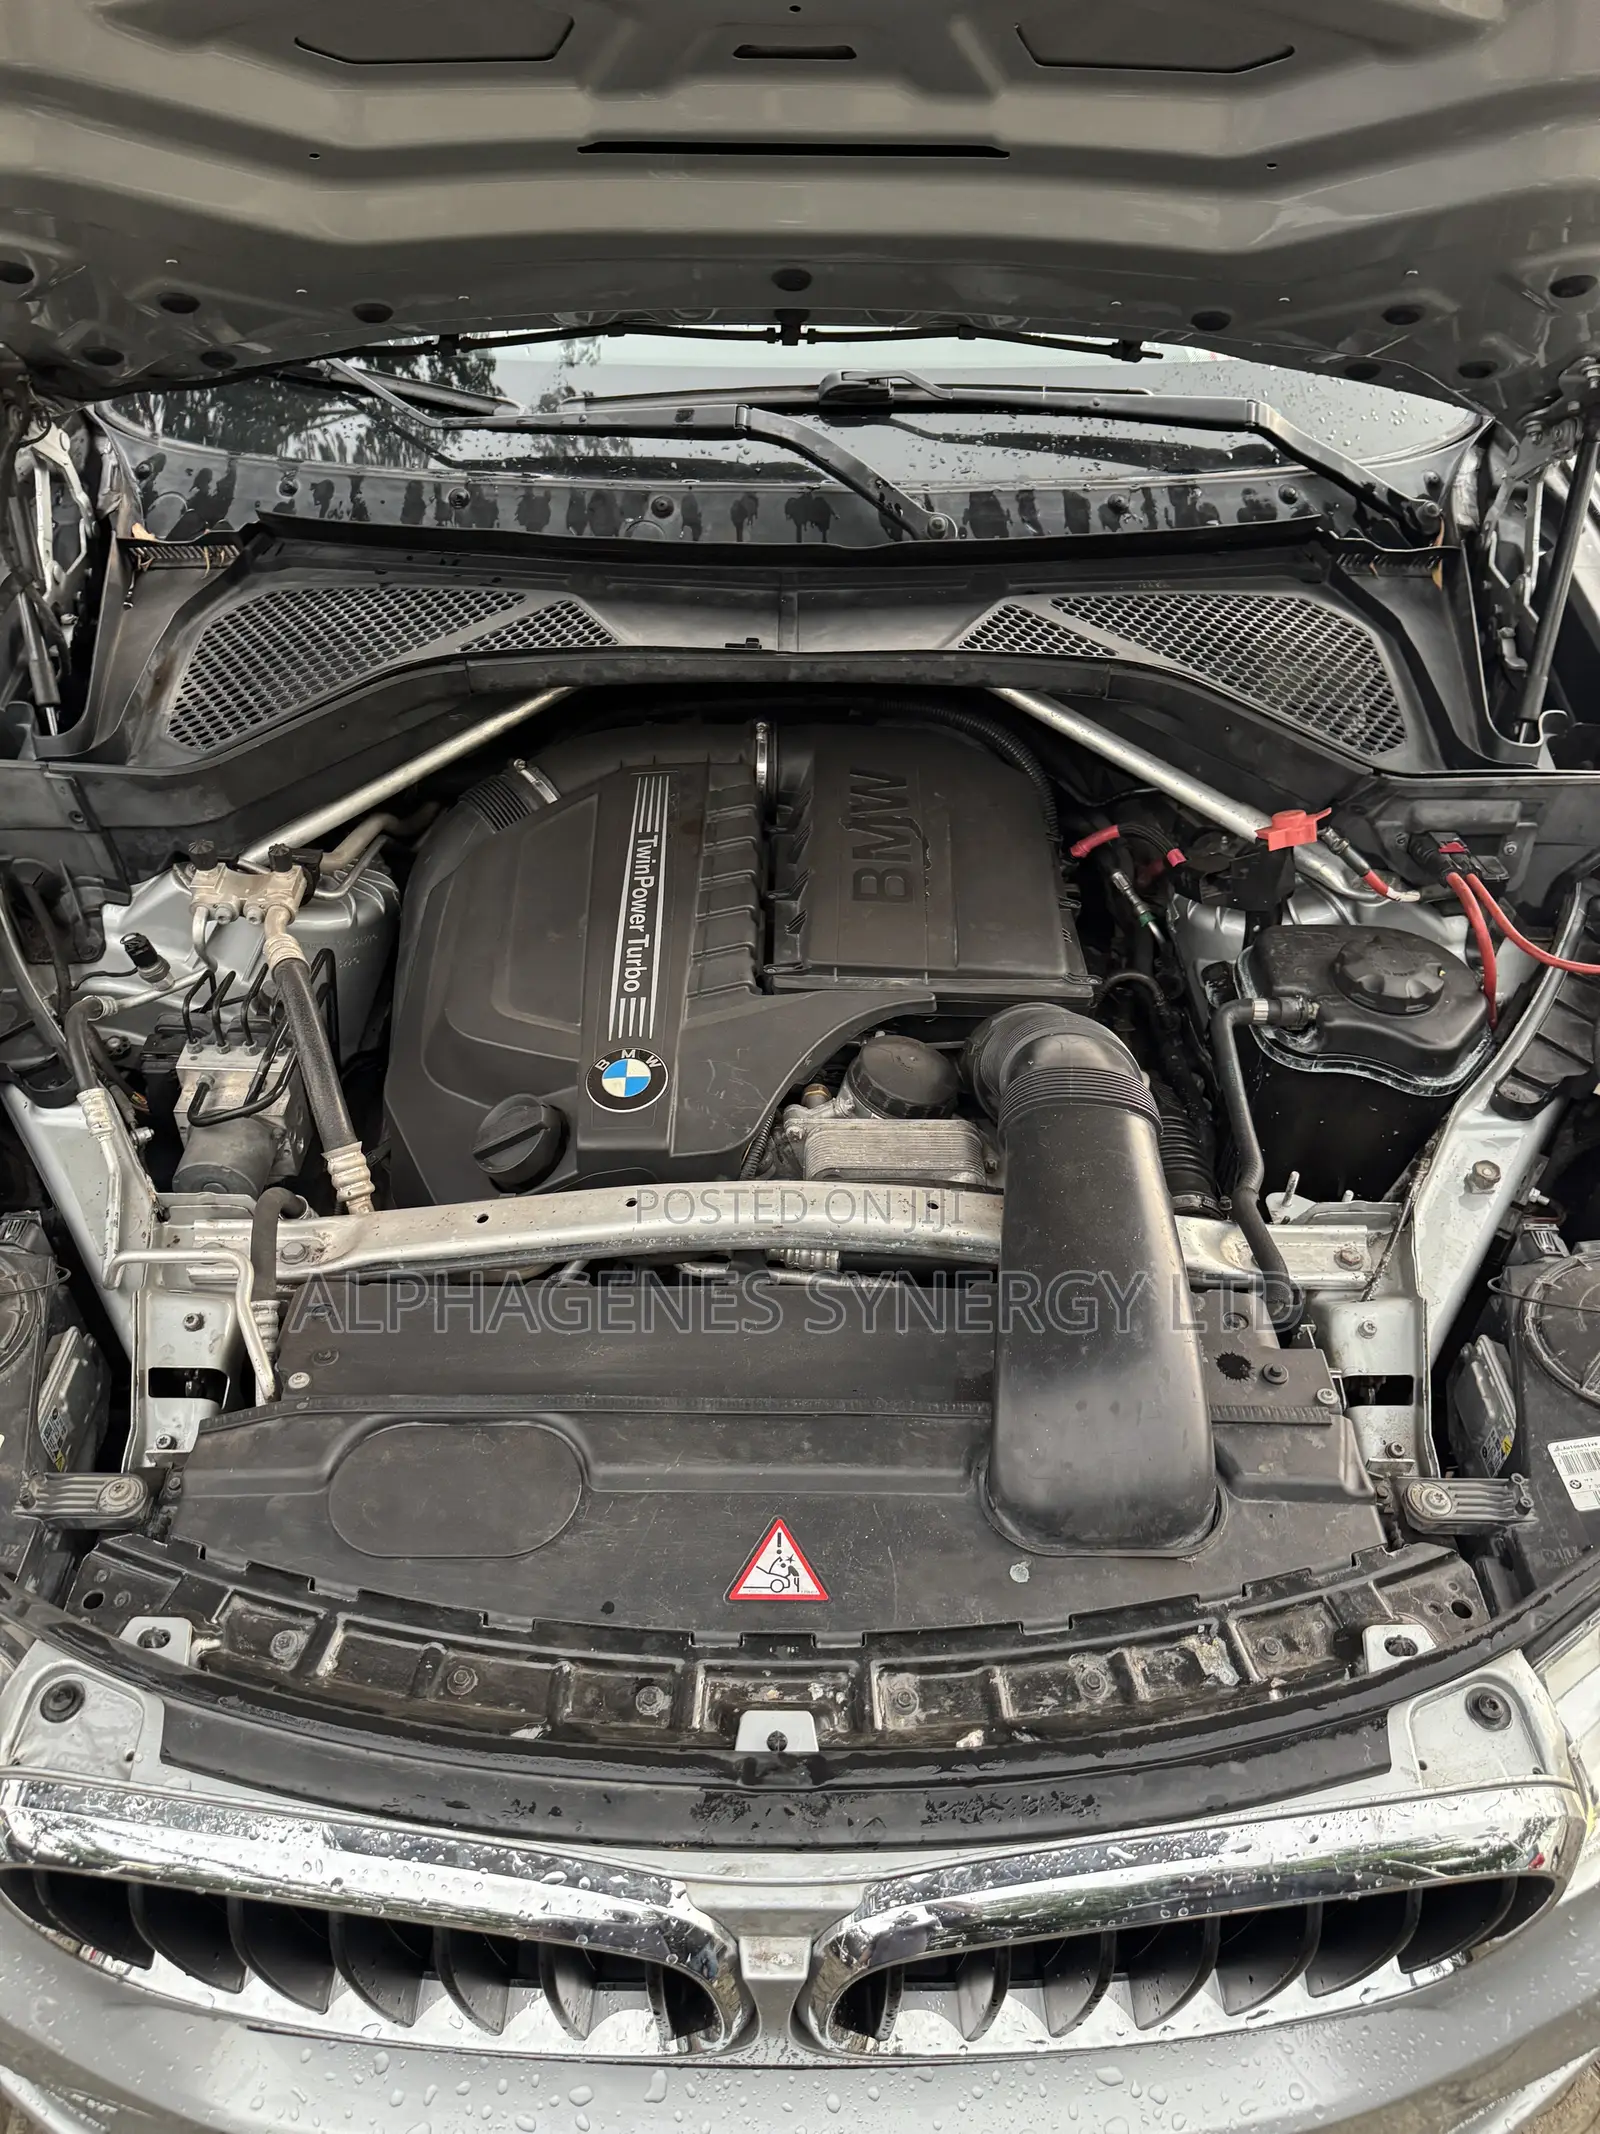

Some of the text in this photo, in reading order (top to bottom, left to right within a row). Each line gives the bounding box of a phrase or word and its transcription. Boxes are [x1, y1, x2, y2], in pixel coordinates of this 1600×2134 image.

[850, 769, 912, 903] BMW
[623, 834, 659, 993] TwinPower Turbo
[594, 1049, 662, 1072] BMW
